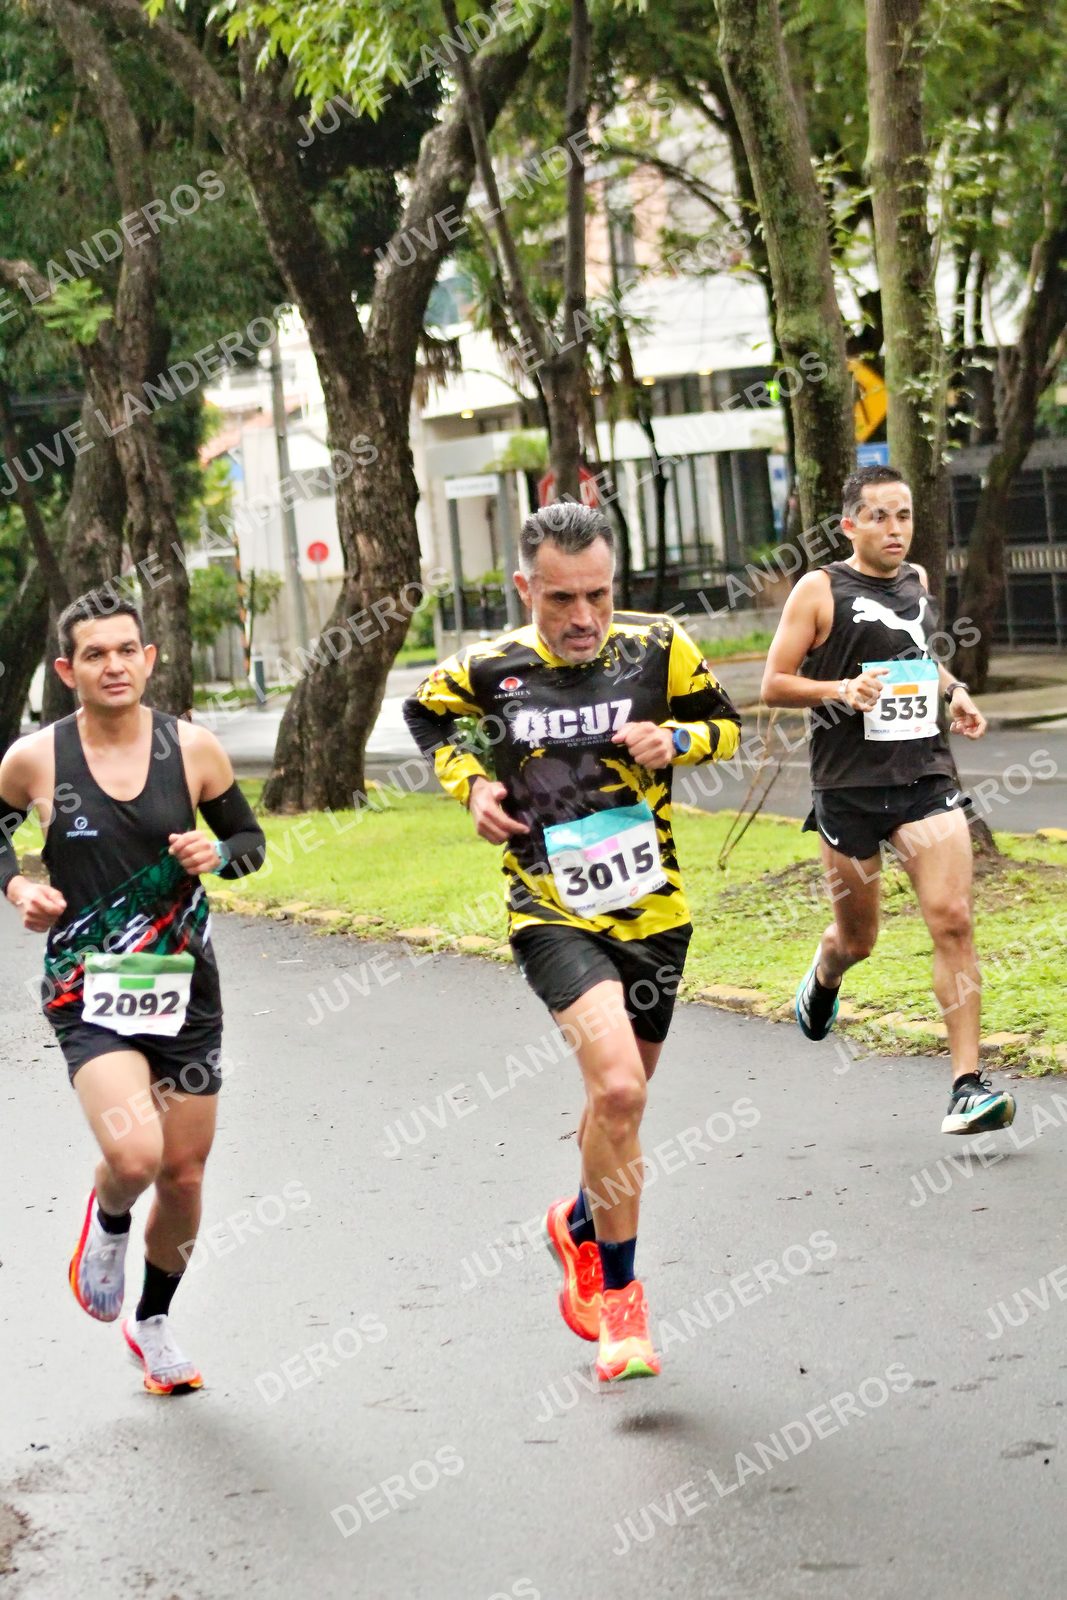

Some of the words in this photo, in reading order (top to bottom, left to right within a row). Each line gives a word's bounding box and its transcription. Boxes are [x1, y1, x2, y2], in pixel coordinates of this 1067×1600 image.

[880, 696, 928, 721] 533
[562, 841, 654, 896] 3015
[92, 991, 180, 1017] 2092
